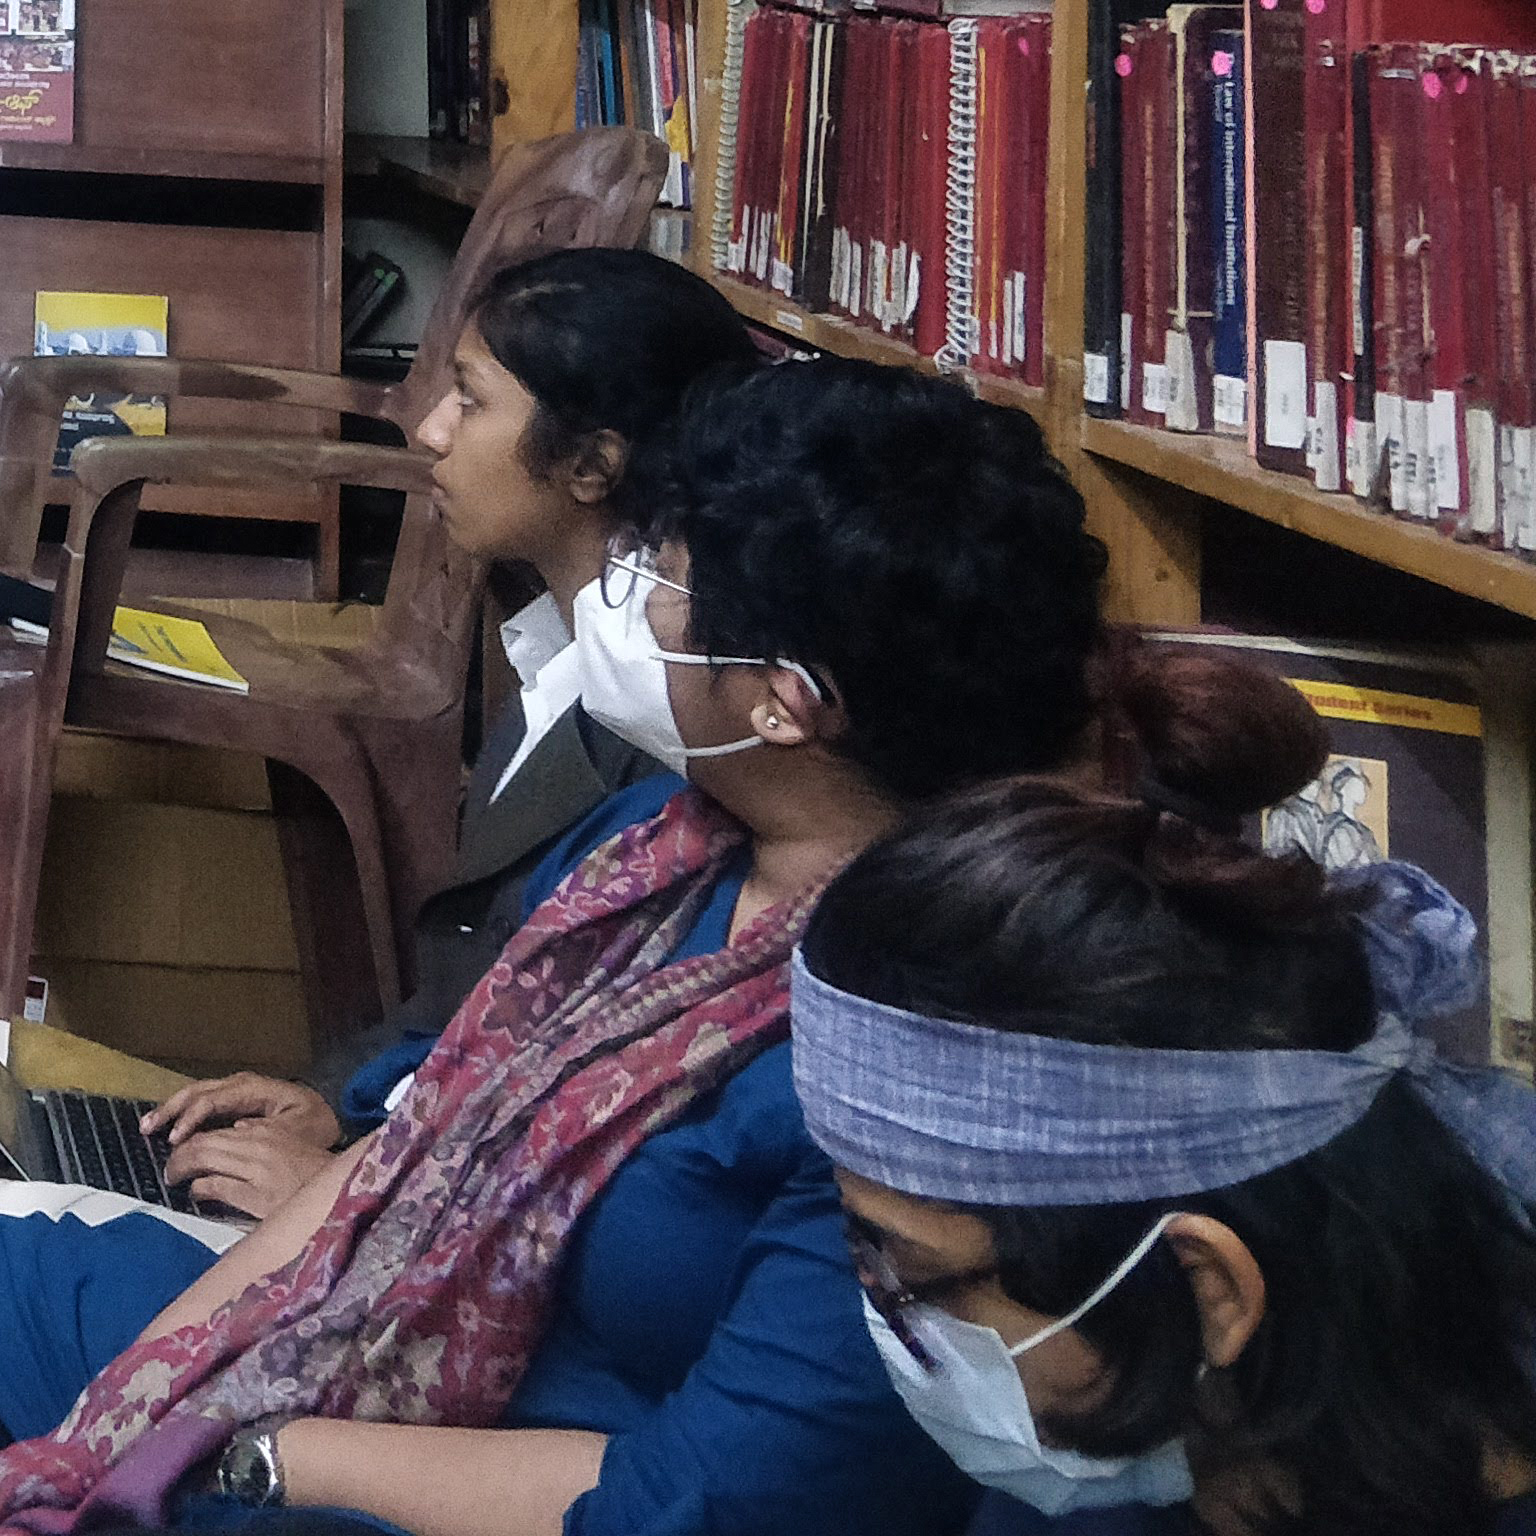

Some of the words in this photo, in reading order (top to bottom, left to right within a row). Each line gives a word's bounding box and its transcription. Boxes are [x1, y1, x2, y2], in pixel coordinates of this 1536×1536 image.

[1224, 81, 1235, 108] Law
[1224, 112, 1234, 127] of
[1224, 131, 1235, 221] International
[1225, 225, 1236, 305] Institutions
